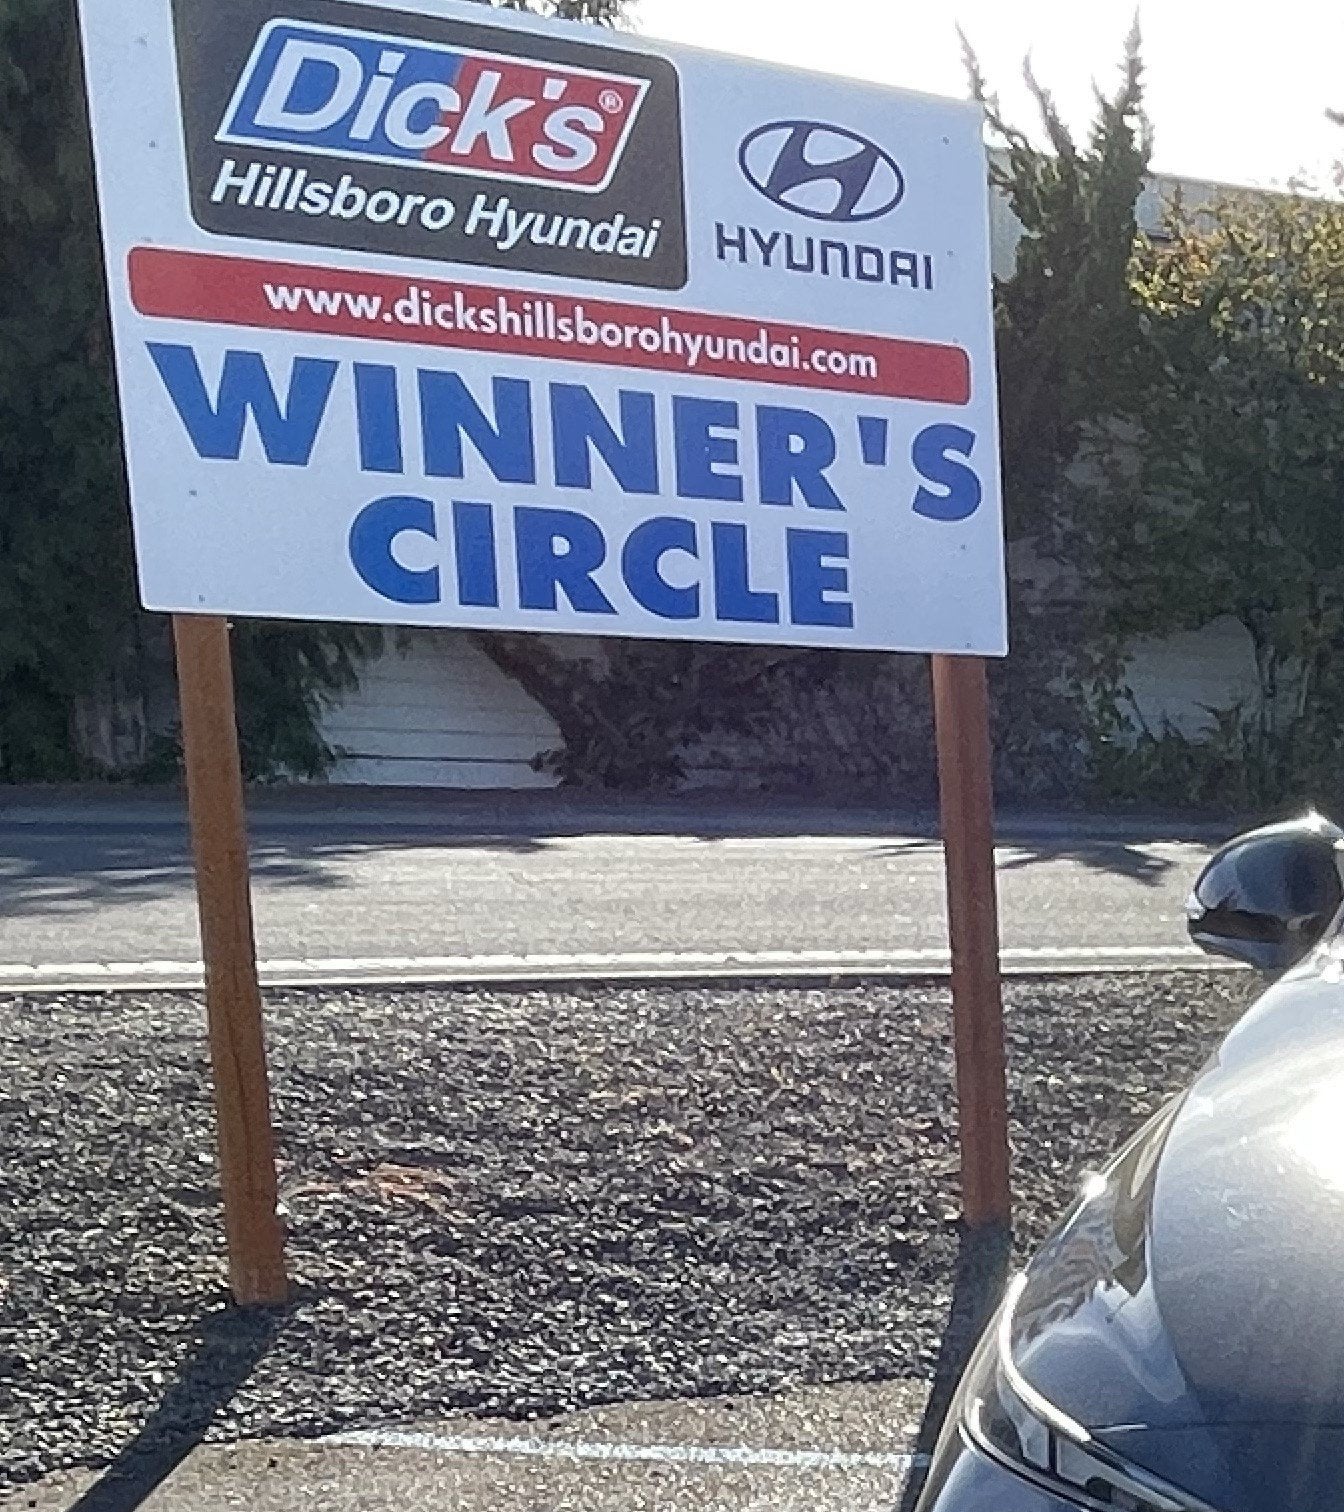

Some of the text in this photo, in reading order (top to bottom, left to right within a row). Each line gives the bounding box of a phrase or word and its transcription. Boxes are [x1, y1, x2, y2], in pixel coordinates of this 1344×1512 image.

[211, 157, 662, 262] Hillsboro Hyundai
[713, 221, 936, 291] HYUNDAI
[262, 276, 879, 380] www.dickshillsborohyundai.com
[146, 342, 983, 522] WINNER'S
[348, 496, 855, 630] CIRCLE
